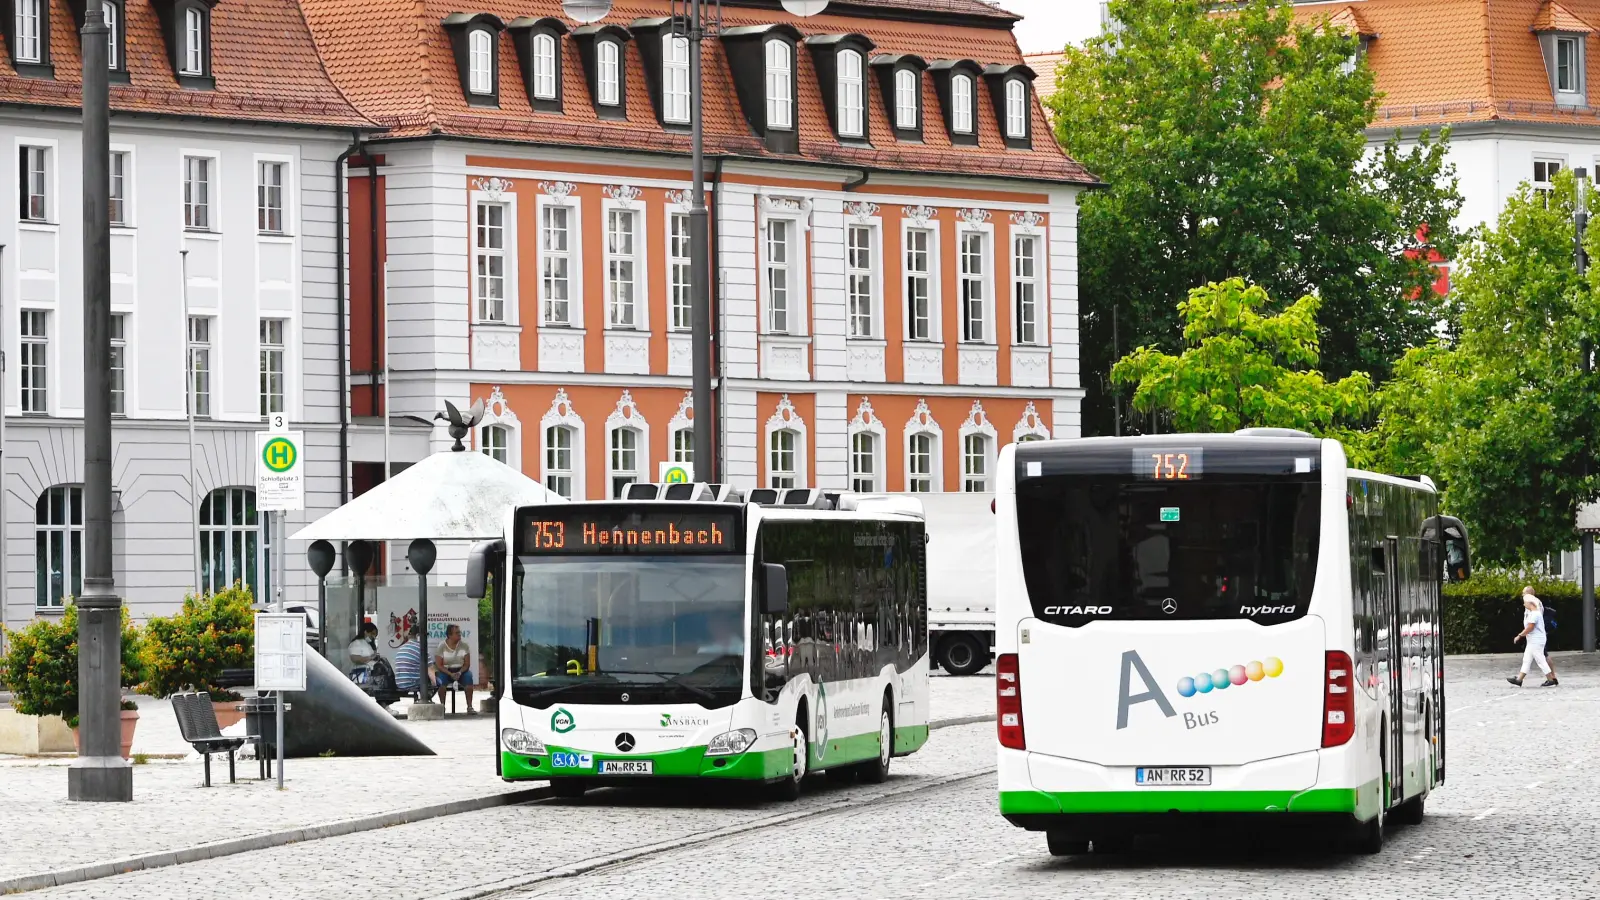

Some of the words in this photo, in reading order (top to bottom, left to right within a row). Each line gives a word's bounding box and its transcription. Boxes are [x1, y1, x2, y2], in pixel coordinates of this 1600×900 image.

[275, 416, 283, 427] 3
[272, 446, 287, 464] H
[1152, 453, 1188, 479] 752
[532, 521, 565, 548] 753
[583, 522, 722, 545] Hennenbach
[1044, 605, 1112, 615] CITARO
[1239, 604, 1296, 616] hybrid
[1116, 649, 1177, 730] A
[665, 717, 709, 726] ANSBACH
[1183, 708, 1220, 730] Bus
[606, 762, 618, 772] AN
[623, 762, 635, 772] RR
[636, 762, 648, 772] 51
[1147, 769, 1163, 781] AN
[1170, 769, 1186, 781] RR
[1189, 769, 1204, 781] 52
